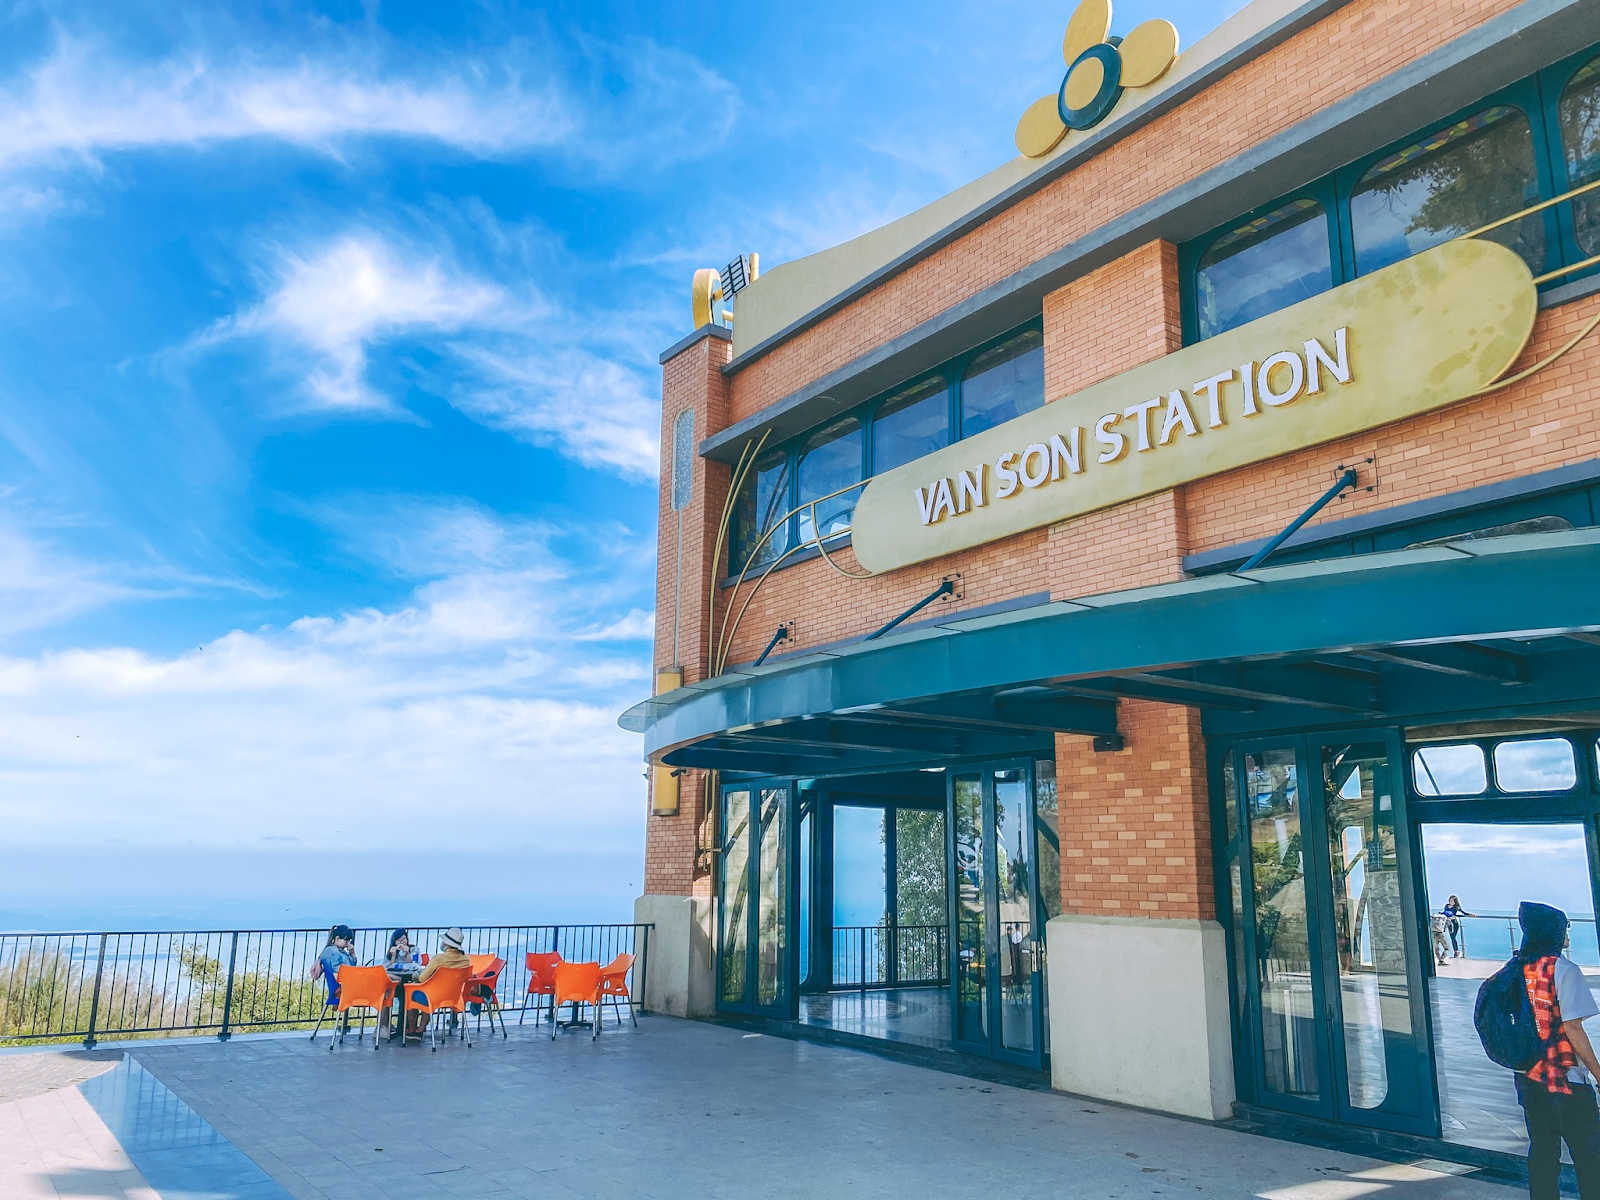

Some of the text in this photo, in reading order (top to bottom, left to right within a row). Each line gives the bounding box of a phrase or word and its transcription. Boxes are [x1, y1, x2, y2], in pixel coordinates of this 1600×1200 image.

[914, 327, 1355, 526] VAN SON STATION
